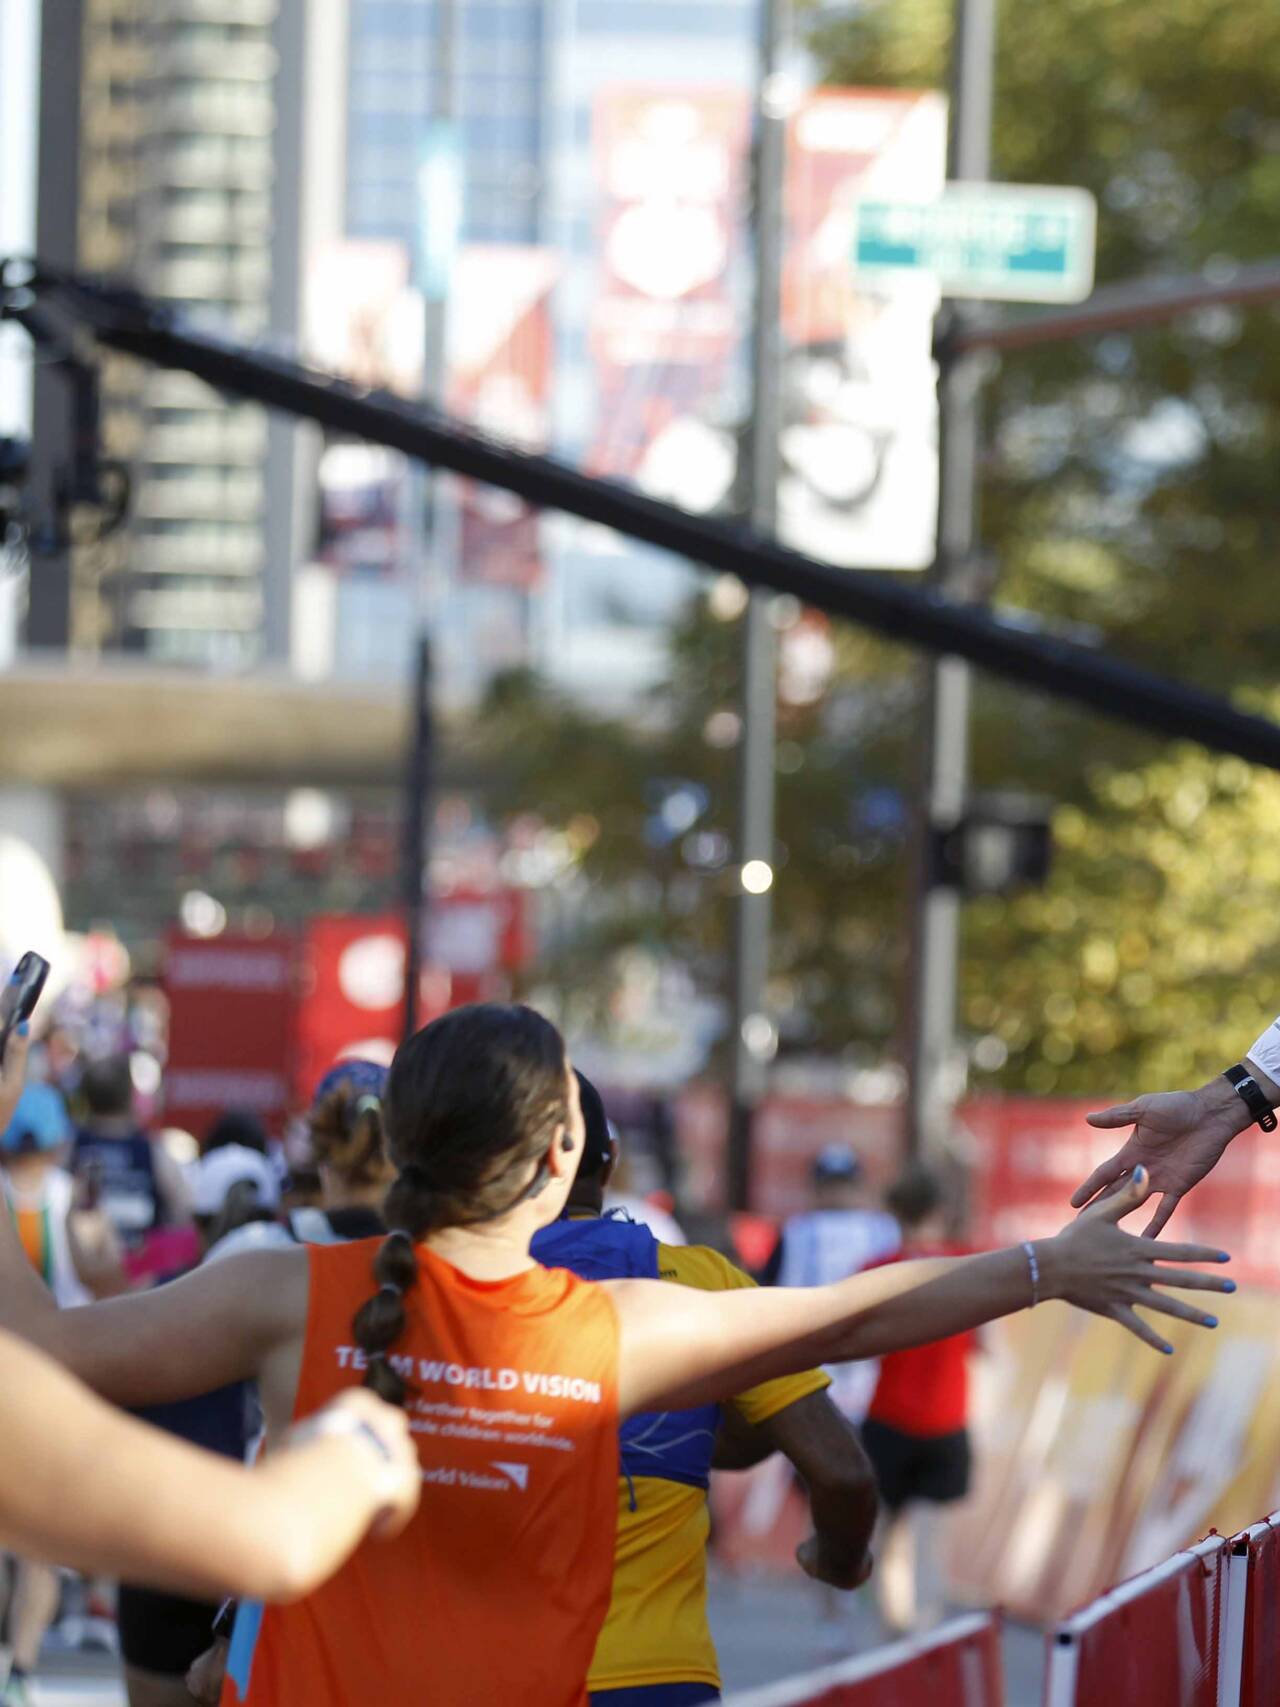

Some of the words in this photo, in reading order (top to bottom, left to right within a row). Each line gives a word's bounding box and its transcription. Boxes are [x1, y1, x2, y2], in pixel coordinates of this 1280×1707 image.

[335, 1345, 415, 1378] TEM
[419, 1359, 519, 1391] WORLD
[522, 1371, 601, 1404] VISION
